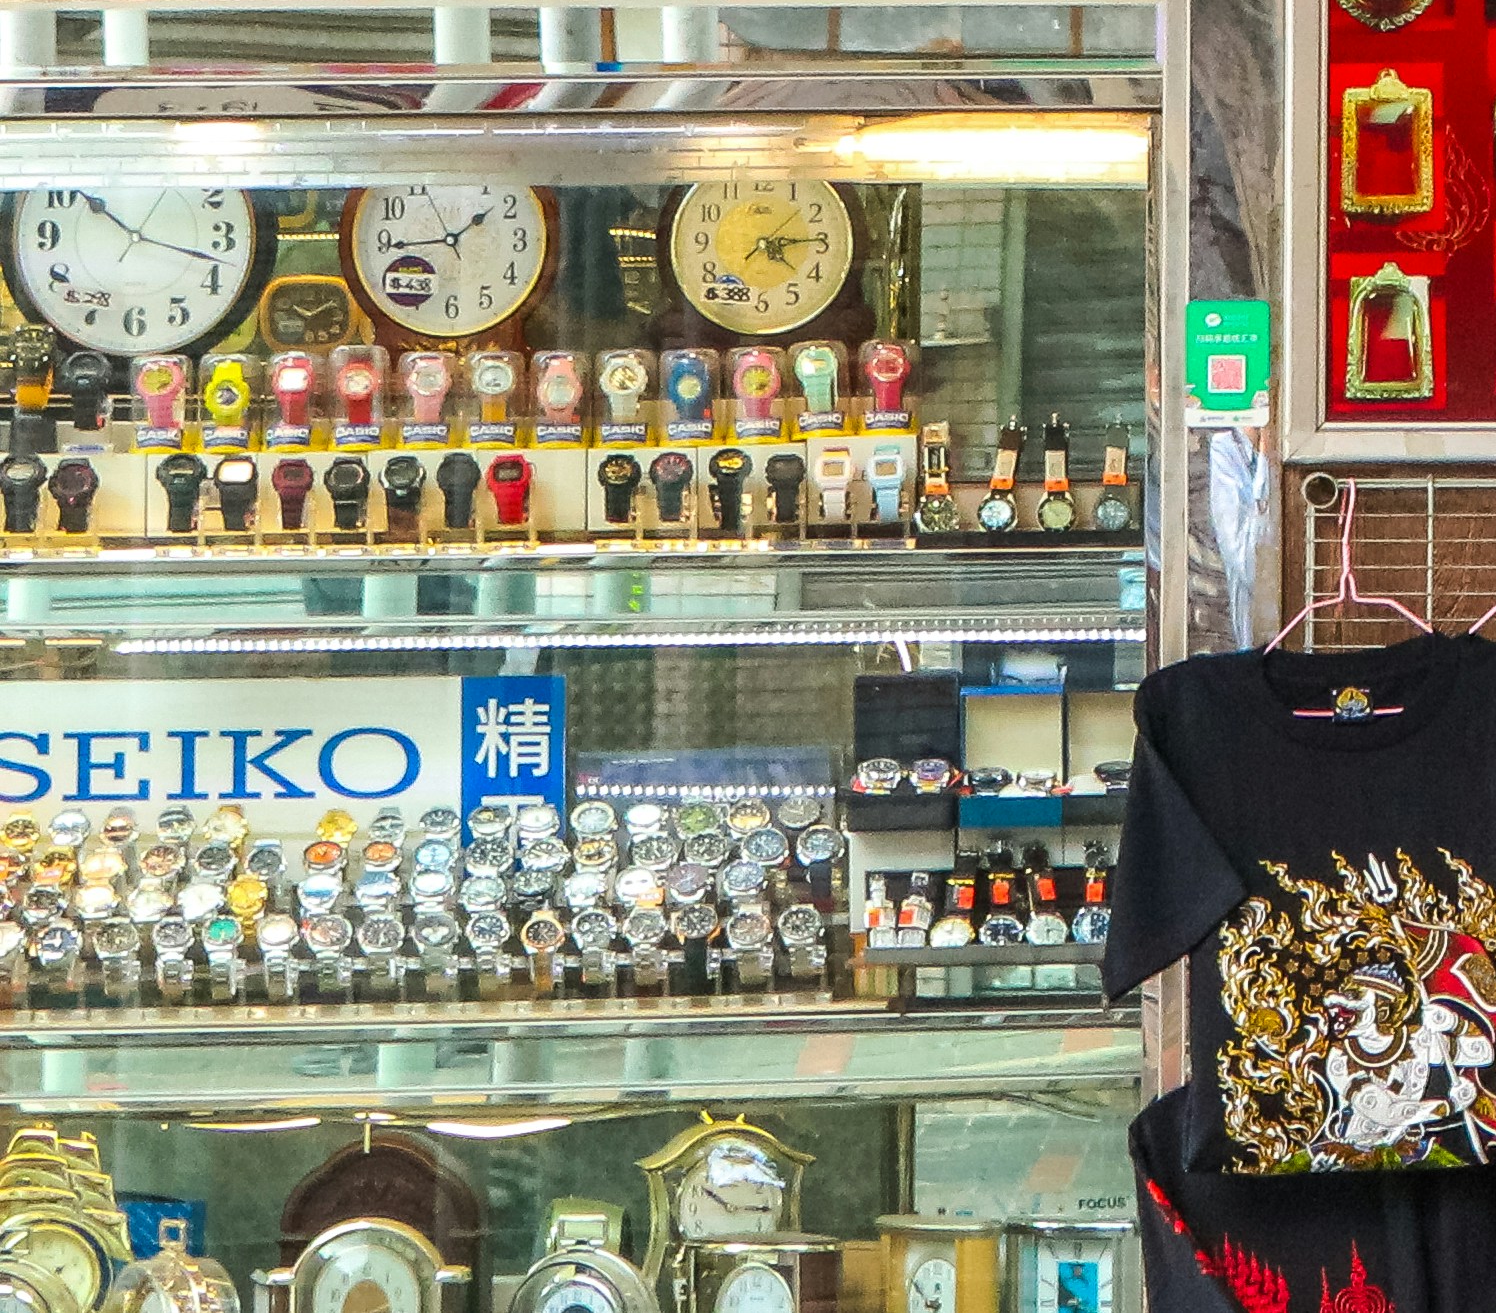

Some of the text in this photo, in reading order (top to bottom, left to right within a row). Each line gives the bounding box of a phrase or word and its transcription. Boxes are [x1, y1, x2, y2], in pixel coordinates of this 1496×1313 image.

[381, 195, 406, 222] 10
[503, 194, 518, 220] 2
[700, 203, 722, 223] 10
[808, 202, 824, 224] 2
[37, 219, 62, 251] 9
[211, 220, 236, 252] 3
[377, 228, 393, 254] 9
[512, 227, 528, 253] 3
[694, 231, 710, 254] 9
[200, 262, 223, 296] 4
[502, 260, 518, 286] 4
[701, 260, 718, 284] 8
[806, 260, 824, 284] 4
[444, 295, 460, 319] 6
[478, 285, 494, 310] 5
[754, 290, 770, 314] 6
[785, 282, 801, 306] 5
[122, 306, 147, 337] 6
[167, 294, 191, 327] 5
[0, 727, 423, 803] SEIKO
[1078, 1197, 1127, 1210] FOCUS
